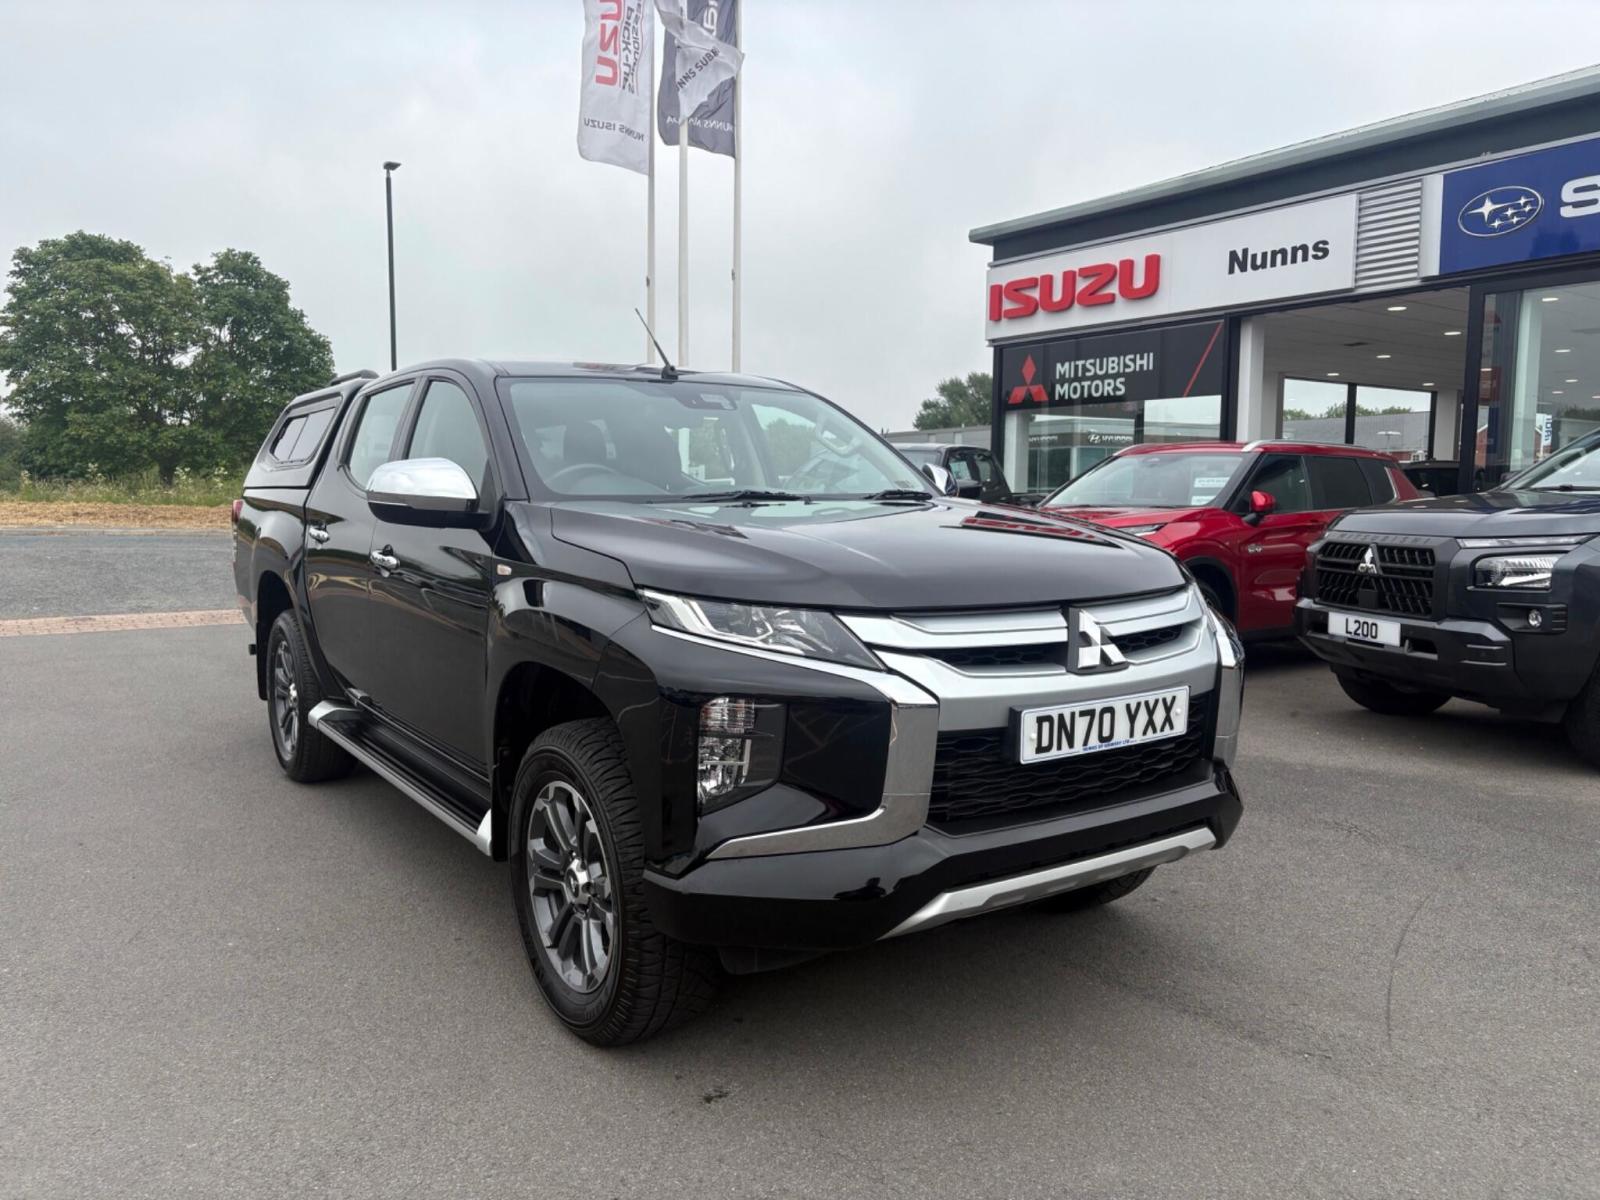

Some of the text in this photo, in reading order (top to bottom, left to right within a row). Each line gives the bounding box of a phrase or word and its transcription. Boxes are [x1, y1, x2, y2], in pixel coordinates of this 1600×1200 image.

[1228, 239, 1330, 275] Nunns
[989, 254, 1161, 322] ISUZU
[1055, 352, 1154, 380] MITSUBISHI
[1055, 377, 1126, 401] MOTORS
[1344, 617, 1378, 640] L200
[1035, 695, 1176, 754] DN70 YXX
